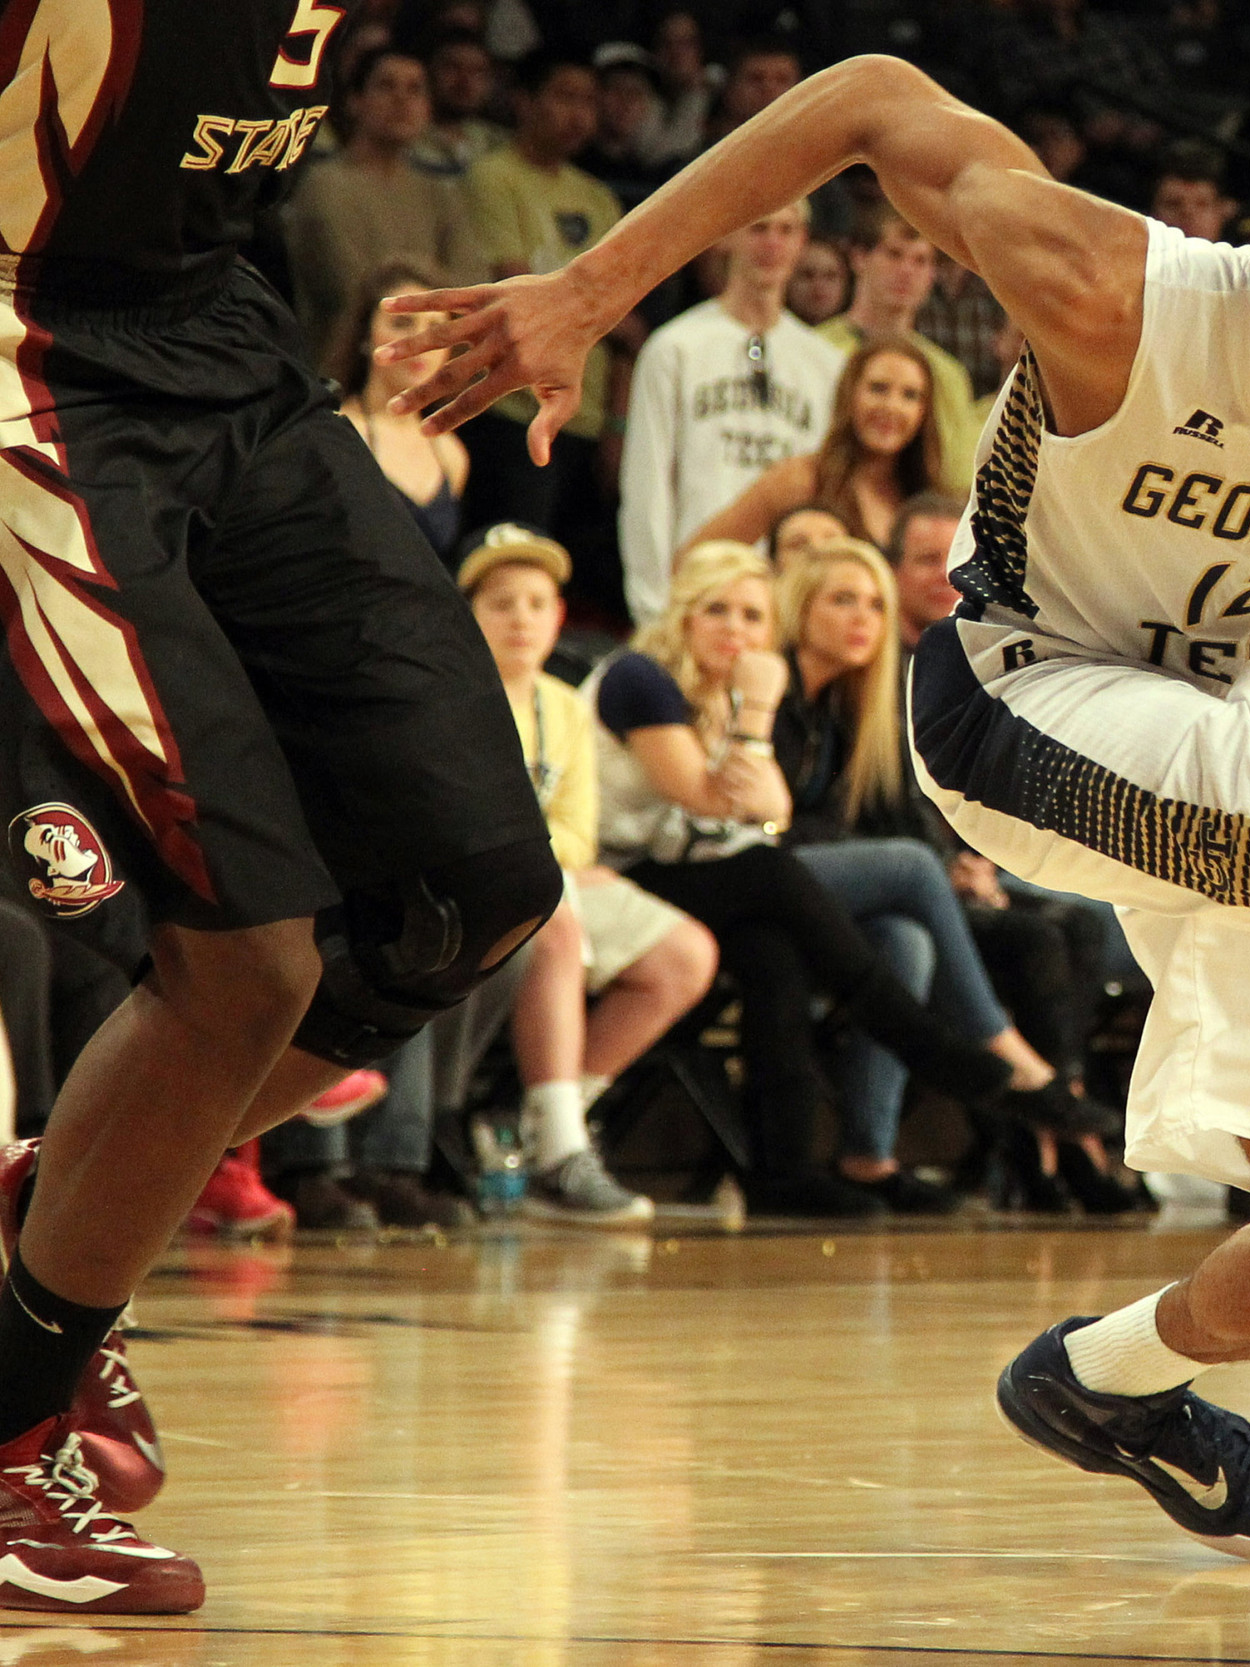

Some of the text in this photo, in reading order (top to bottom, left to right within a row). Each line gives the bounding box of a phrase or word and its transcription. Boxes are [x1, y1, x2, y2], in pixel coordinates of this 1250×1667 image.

[268, 0, 347, 90] 5
[179, 105, 329, 174] STATE
[693, 375, 812, 431] GEOGIA
